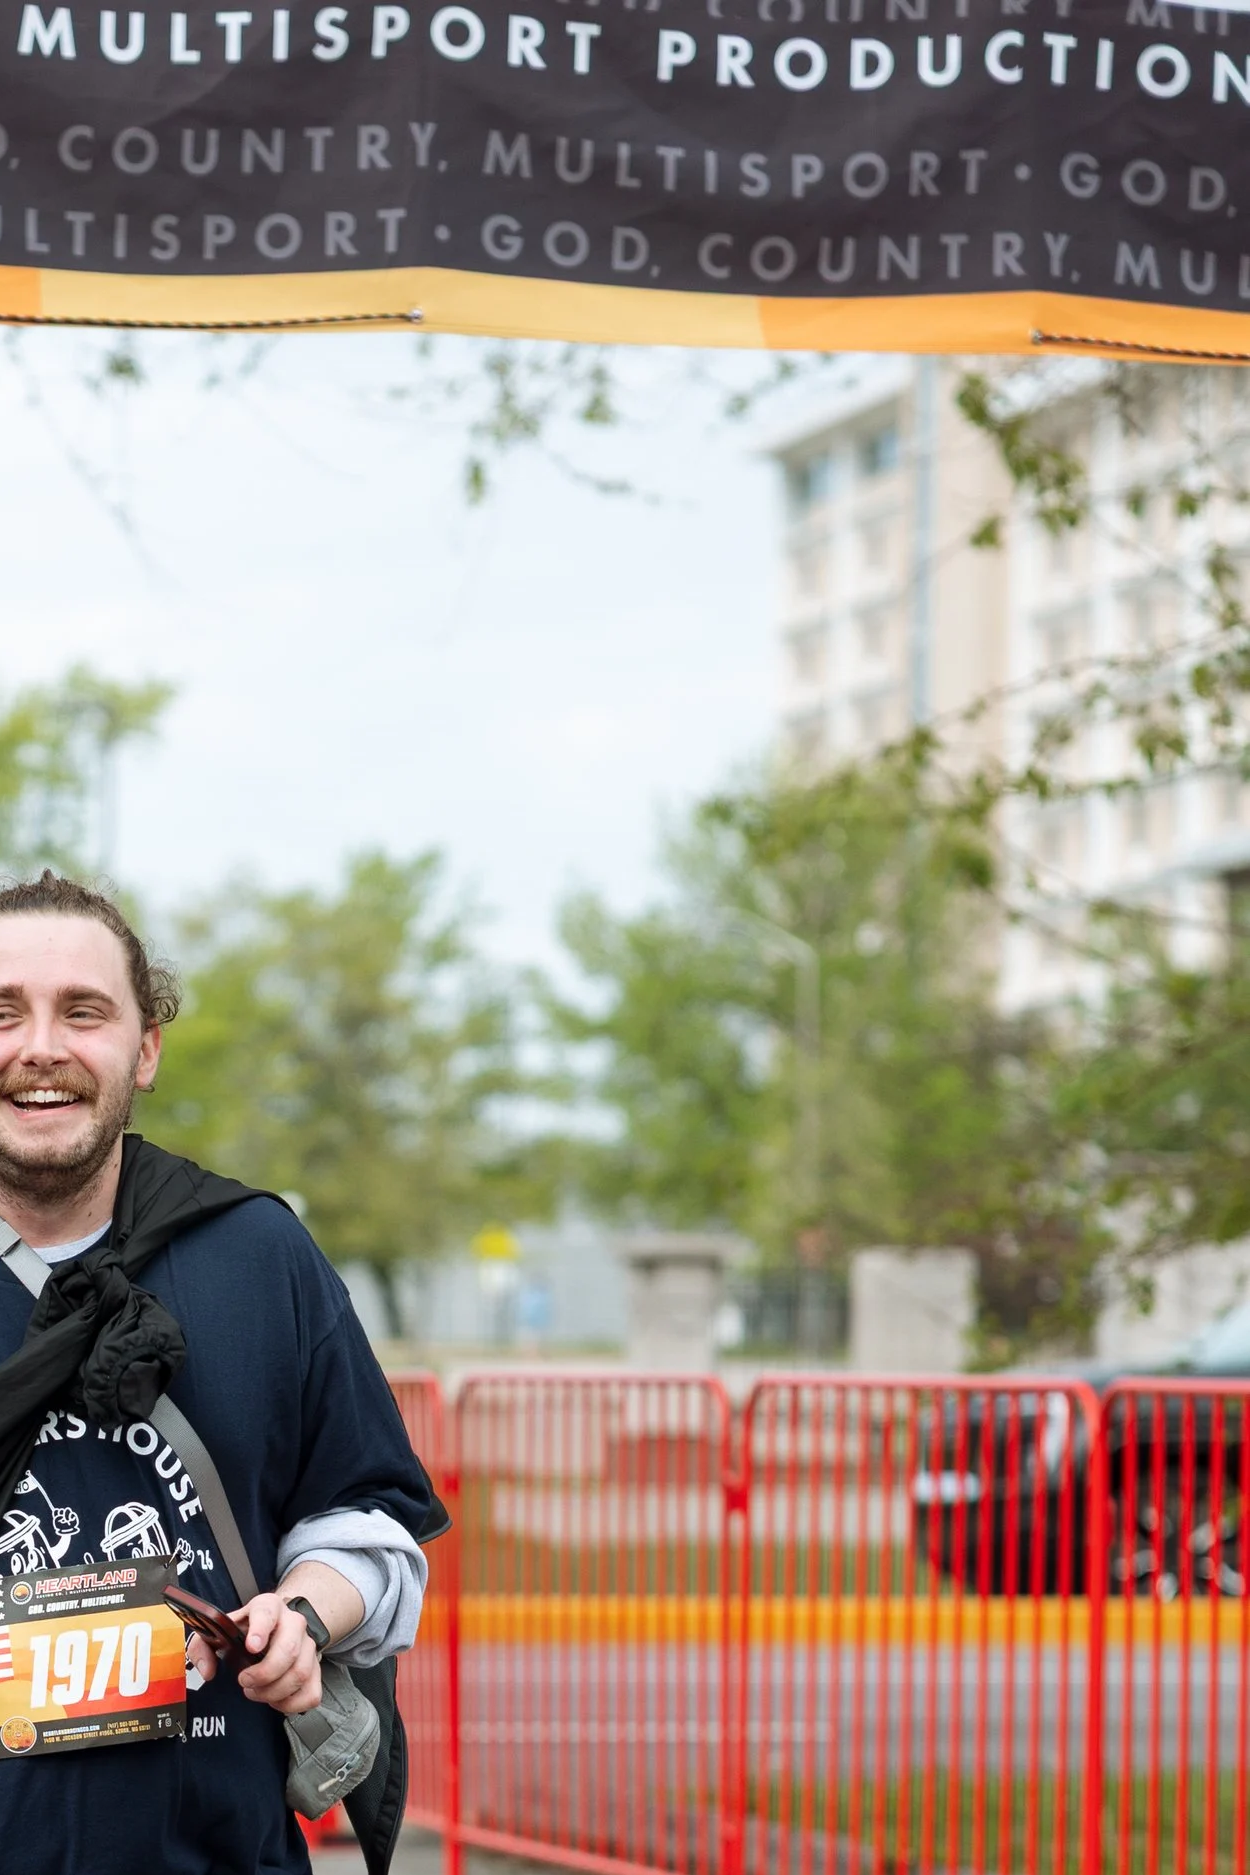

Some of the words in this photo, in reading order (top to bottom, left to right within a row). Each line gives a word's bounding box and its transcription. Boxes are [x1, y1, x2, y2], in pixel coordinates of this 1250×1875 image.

[17, 4, 602, 76] MULTISPORT
[656, 28, 1250, 108] PRODUCTION
[58, 121, 448, 176] COUNTRY,
[482, 130, 988, 199] MULTISPORT
[1059, 152, 1238, 219] GOD,
[481, 214, 660, 278] GOD,
[699, 231, 1081, 283] COUNTRY,
[34, 1410, 87, 1446] R'S
[34, 1568, 137, 1595] HEARTLAND
[29, 1621, 152, 1710] 1970
[191, 1715, 226, 1738] RUN
